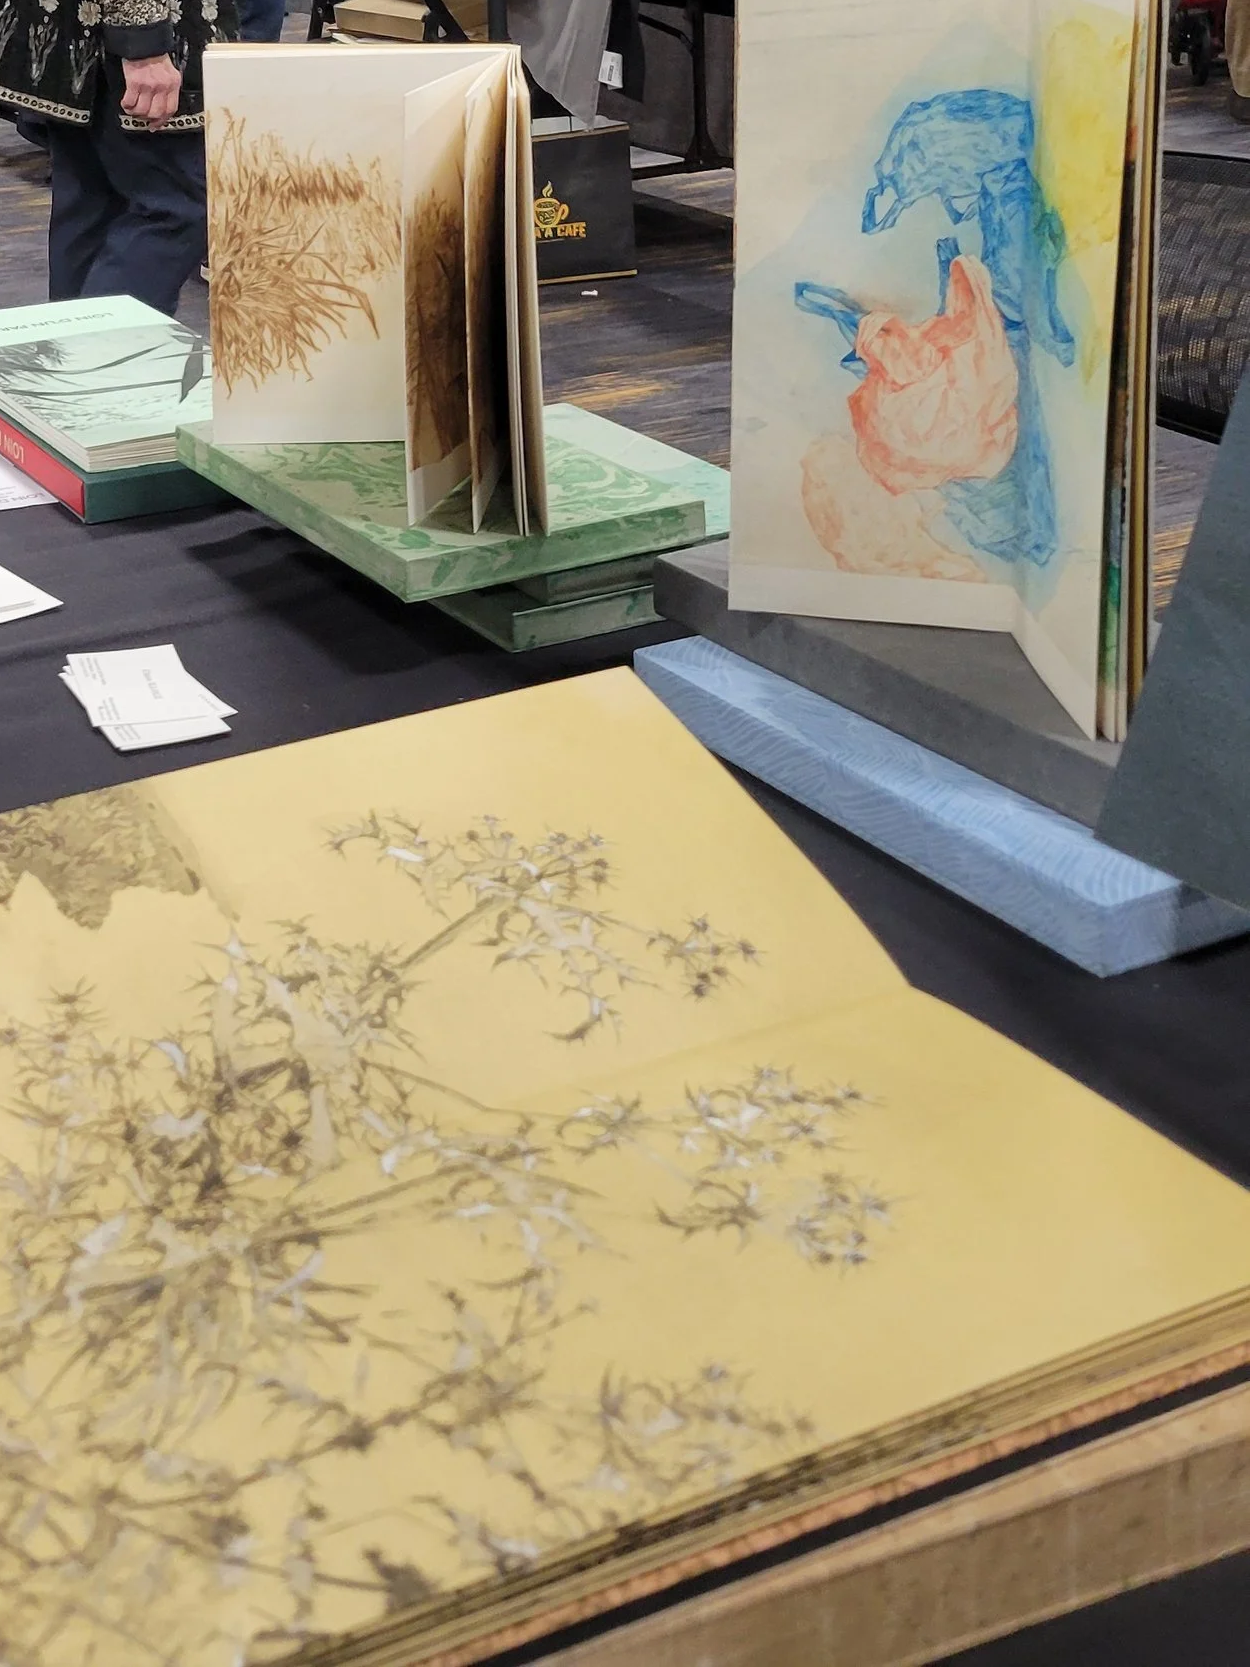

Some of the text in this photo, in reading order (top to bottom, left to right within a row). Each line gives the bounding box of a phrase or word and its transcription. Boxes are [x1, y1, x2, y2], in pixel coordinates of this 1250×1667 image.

[557, 221, 587, 238] CAFE
[31, 318, 72, 328] D'UN
[75, 312, 114, 321] LOIN
[3, 434, 24, 464] LOIN
